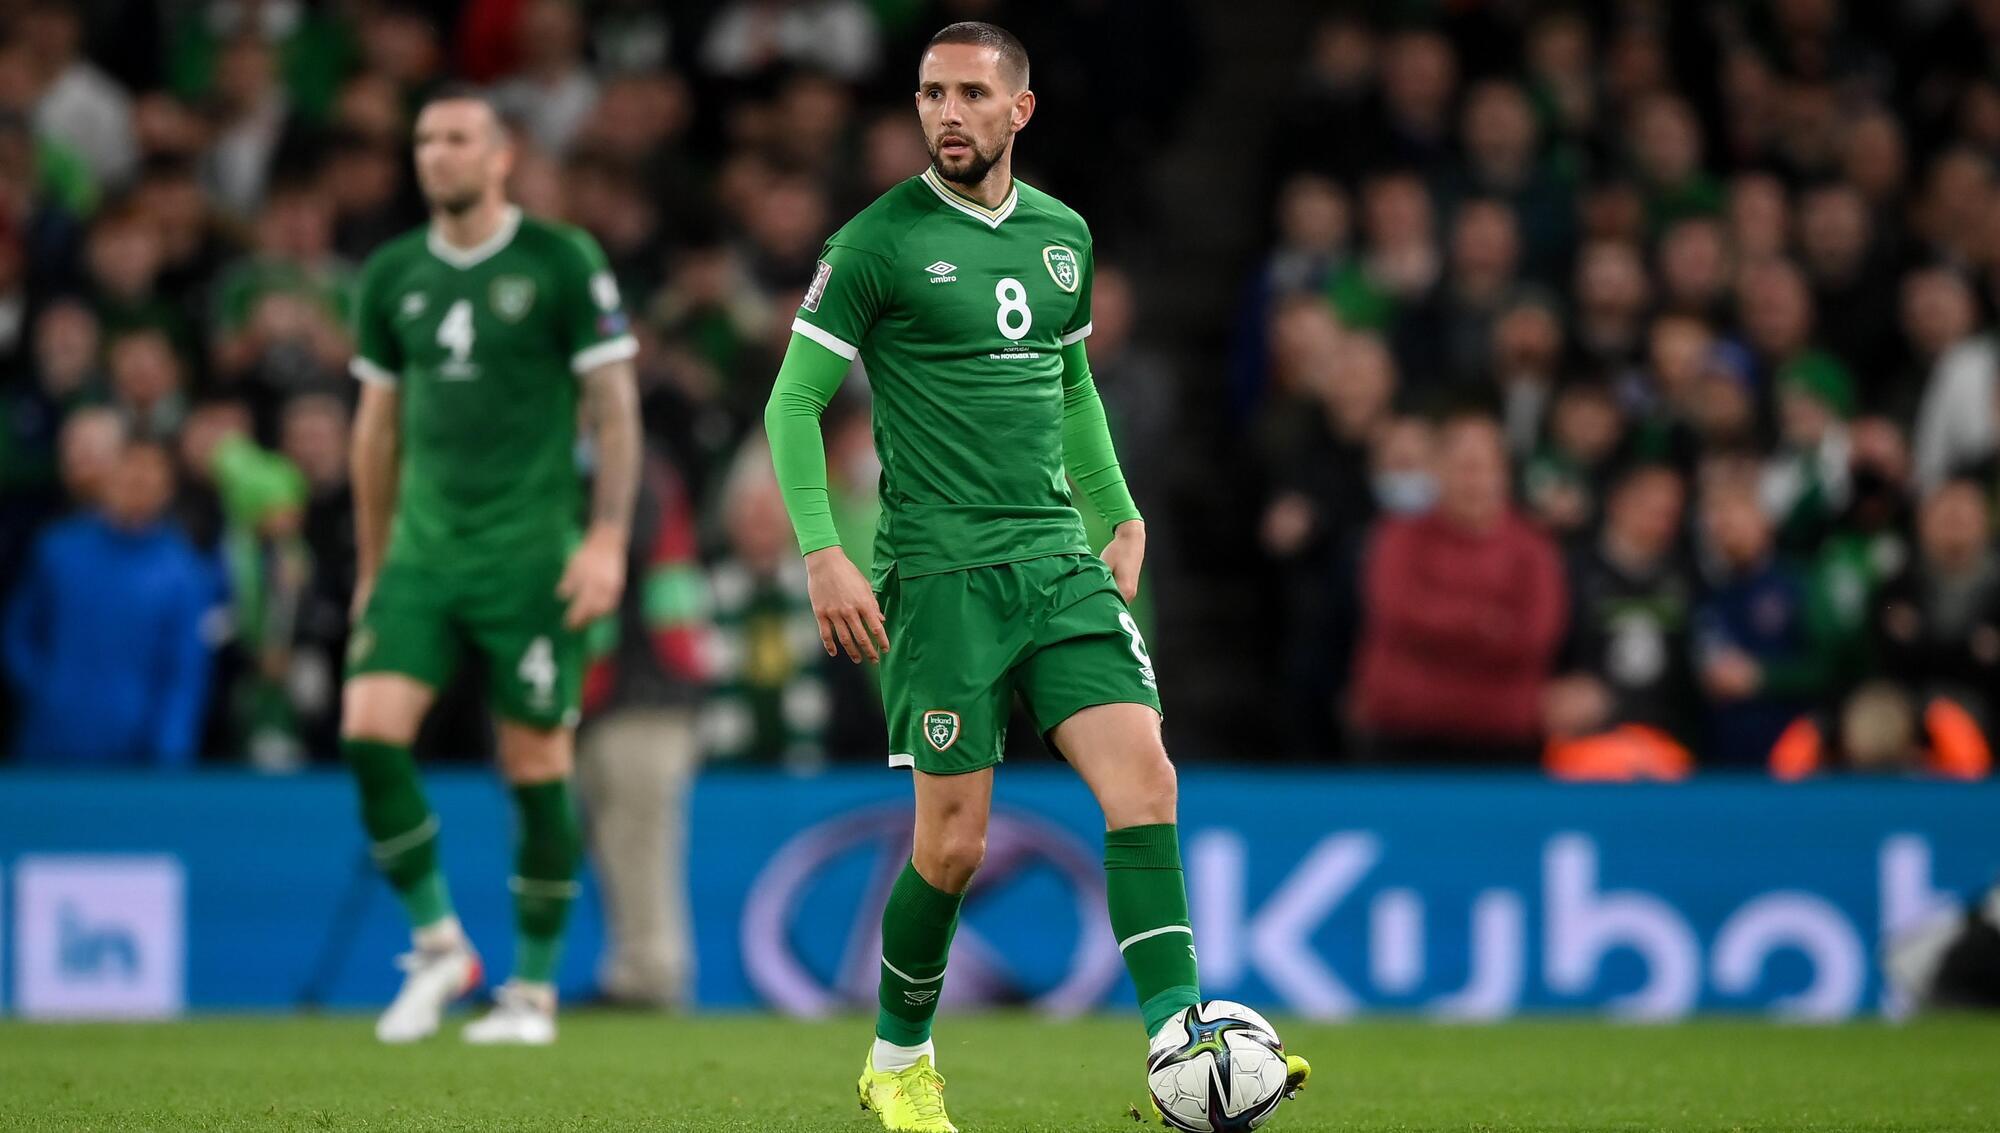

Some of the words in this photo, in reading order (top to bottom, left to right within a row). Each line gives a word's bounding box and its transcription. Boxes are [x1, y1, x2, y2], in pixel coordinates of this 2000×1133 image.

[930, 275, 957, 284] umbro
[995, 277, 1032, 340] 8
[437, 300, 474, 363] 4
[517, 635, 559, 693] 4
[1119, 612, 1152, 667] 8
